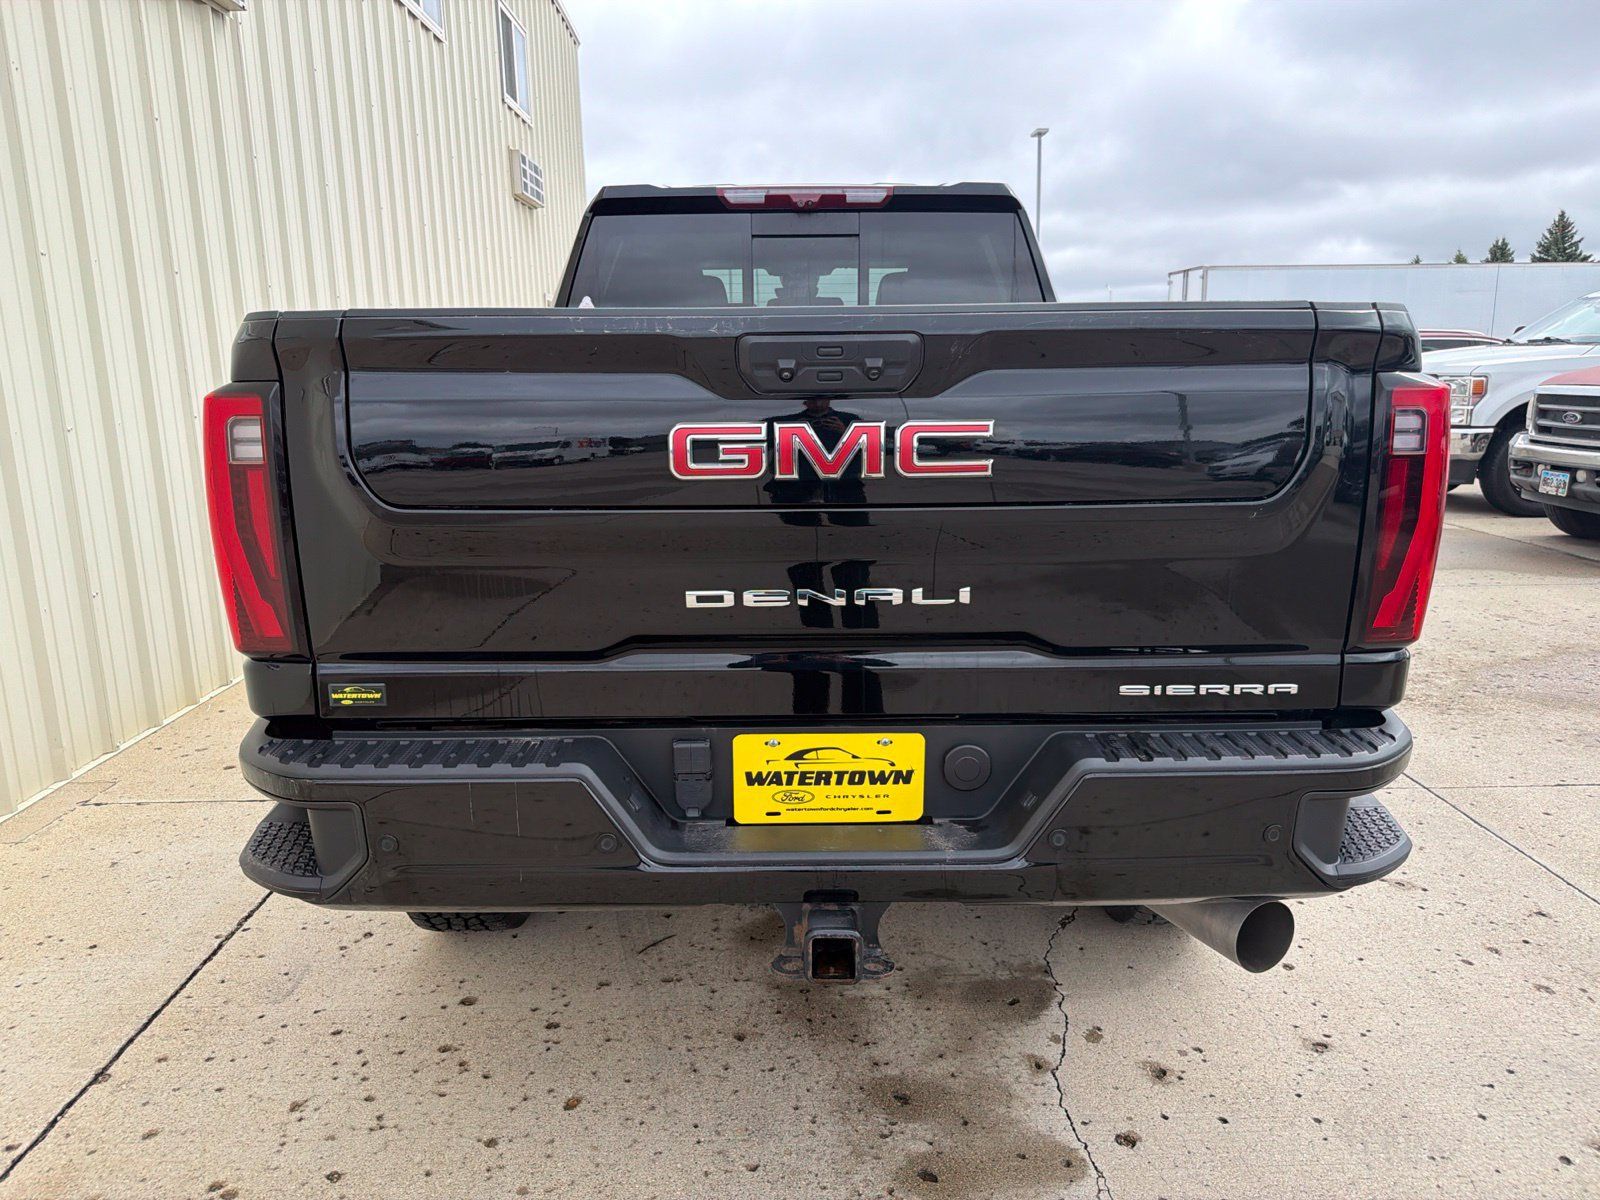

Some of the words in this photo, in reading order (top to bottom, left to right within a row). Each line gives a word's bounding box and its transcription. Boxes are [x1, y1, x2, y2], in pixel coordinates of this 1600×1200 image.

[668, 420, 995, 480] GMC
[685, 587, 971, 608] DENALI
[1118, 684, 1299, 696] SIERRA
[745, 769, 915, 787] WATERTOWN
